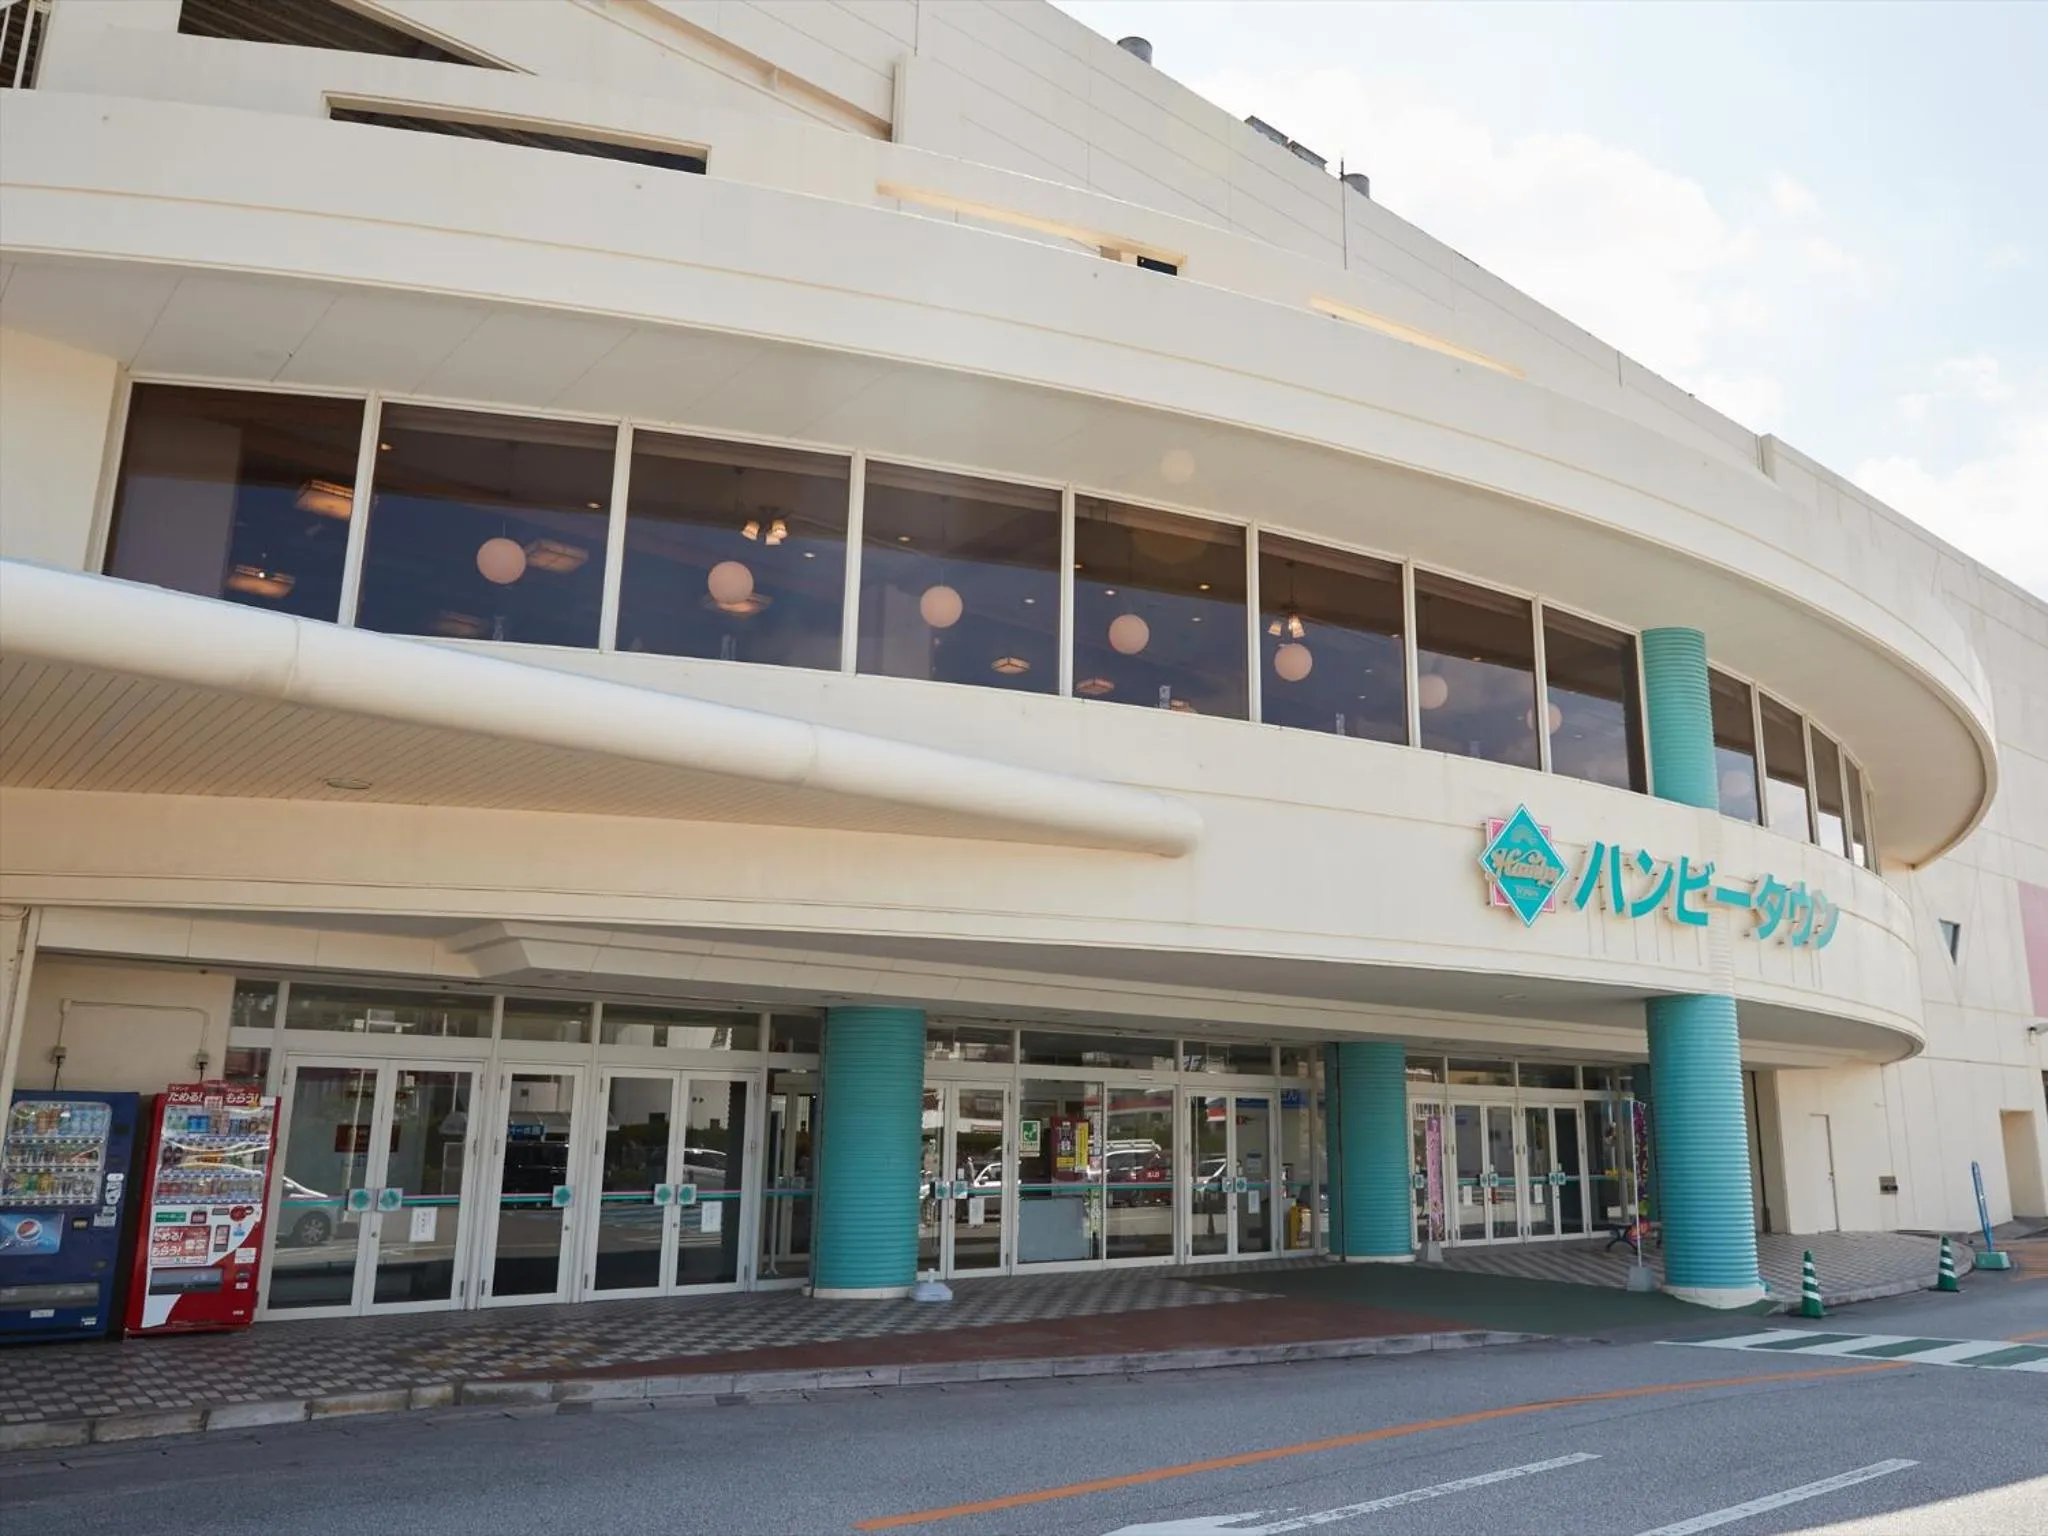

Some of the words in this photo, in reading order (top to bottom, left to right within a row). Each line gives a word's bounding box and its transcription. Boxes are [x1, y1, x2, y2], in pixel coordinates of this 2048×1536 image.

[1571, 840, 1839, 949] ハンビータウン
